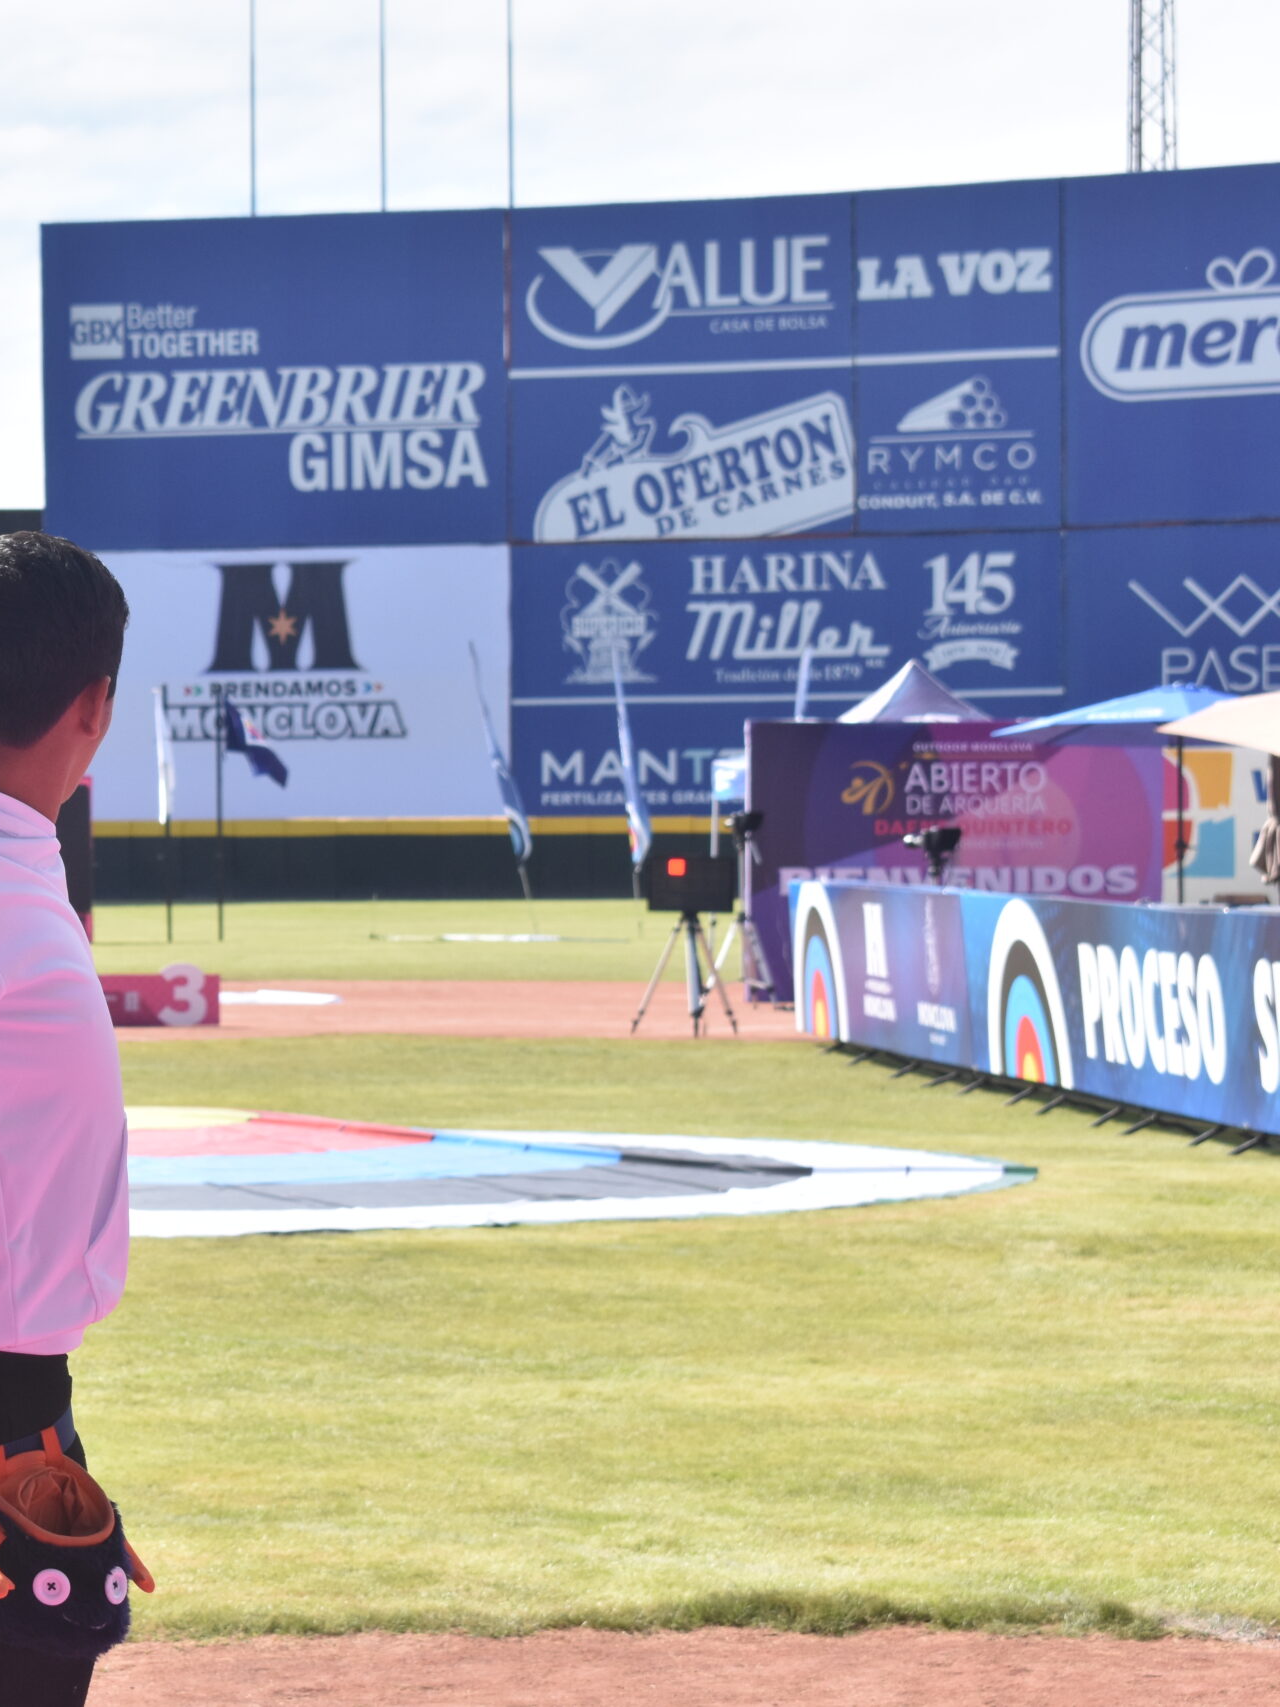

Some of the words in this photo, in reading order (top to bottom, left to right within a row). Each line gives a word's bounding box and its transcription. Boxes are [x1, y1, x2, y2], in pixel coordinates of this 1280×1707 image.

[857, 254, 933, 300] LA
[938, 248, 1052, 296] VOZ
[72, 319, 122, 346] GBX
[127, 303, 198, 331] Better
[710, 318, 750, 334] CASA
[754, 317, 776, 332] DE
[778, 315, 828, 331] BOLSA
[129, 329, 259, 358] TOGETHER
[1116, 316, 1280, 373] mer
[74, 361, 486, 436] GREENBRIER
[289, 430, 488, 492] GIMSA
[566, 487, 625, 538] EL
[633, 413, 840, 517] OFERTON
[867, 442, 1037, 475] RYMCO
[656, 508, 699, 538] DE
[713, 460, 848, 517] CARNES
[981, 489, 1006, 506] DE
[690, 551, 888, 595] HARINA
[922, 552, 1016, 616] 145
[686, 600, 892, 660] Miller
[209, 679, 357, 698] PRENDAMOS
[783, 665, 823, 682] dee
[541, 749, 746, 786] MANT
[904, 762, 1047, 793] ABIERTO
[541, 790, 669, 806] FERTILIZAES
[906, 794, 934, 815] DE
[158, 963, 207, 1027] 3
[1077, 941, 1227, 1086] PROCESO
[1253, 957, 1280, 1094] S
